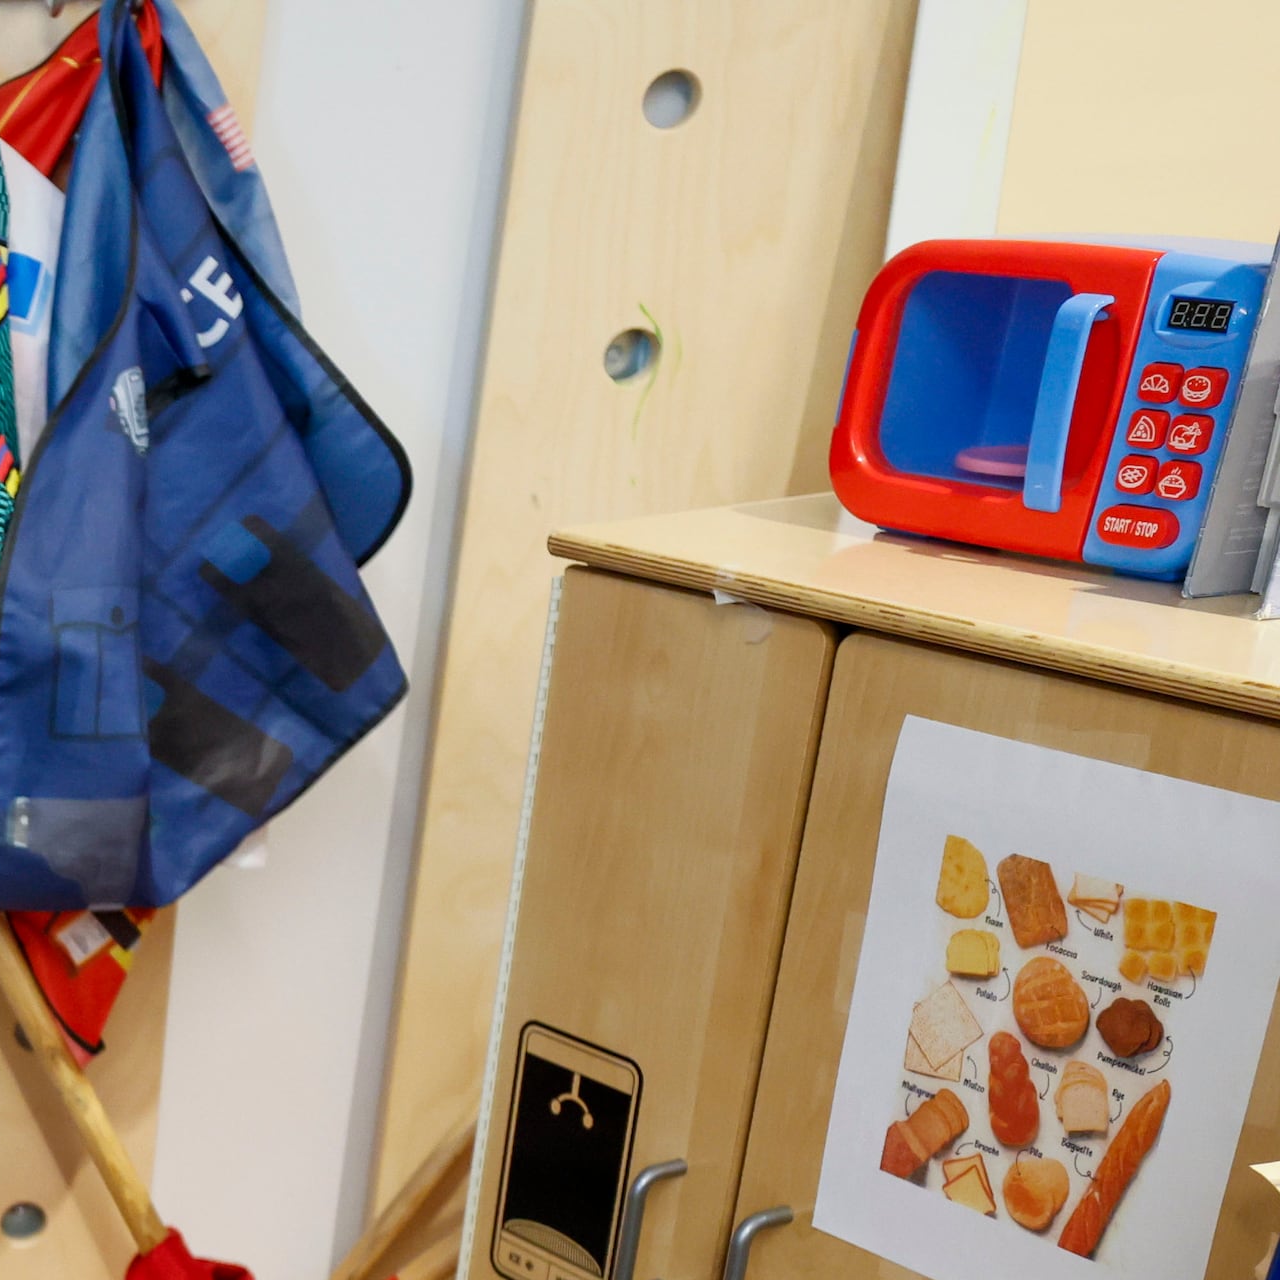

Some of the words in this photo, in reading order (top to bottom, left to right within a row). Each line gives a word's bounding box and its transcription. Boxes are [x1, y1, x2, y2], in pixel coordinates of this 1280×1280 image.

[1134, 521, 1159, 538] STOP
[1046, 941, 1078, 960] Focaccia
[1081, 970, 1123, 993] Sourdough
[1031, 1057, 1059, 1075] Challah
[1096, 1051, 1147, 1077] Pumpernickel
[1111, 1088, 1126, 1102] Rye
